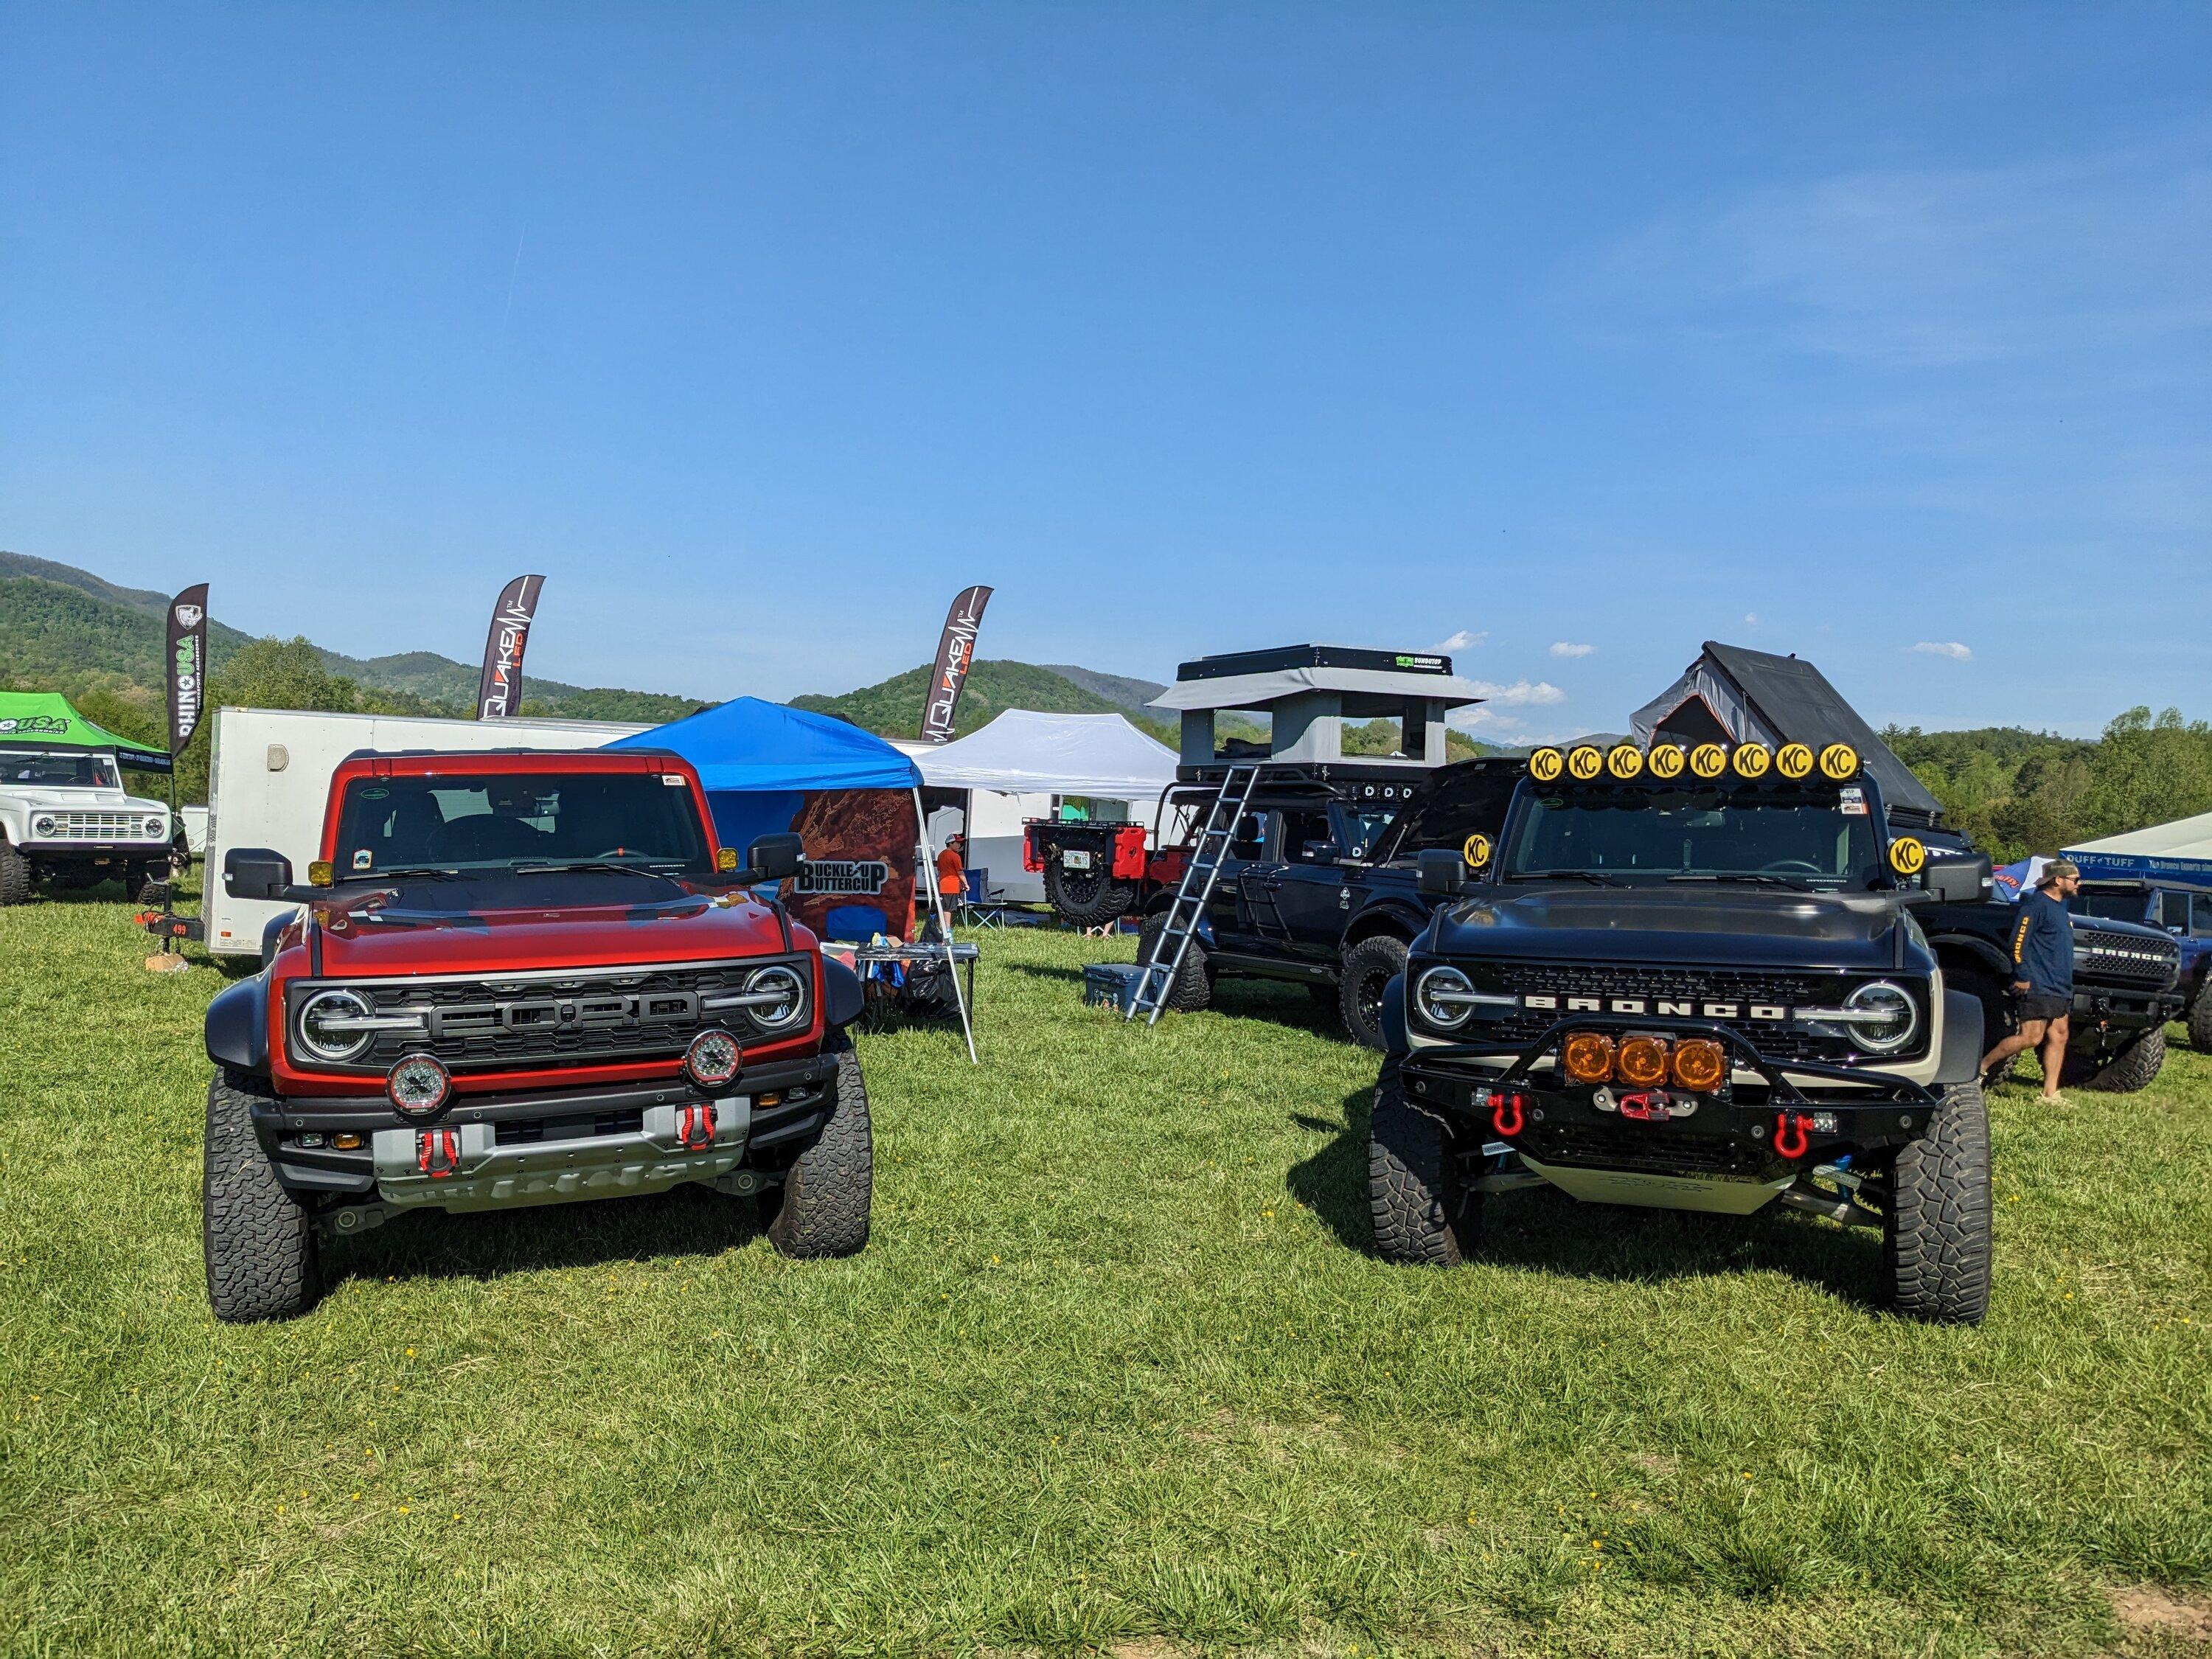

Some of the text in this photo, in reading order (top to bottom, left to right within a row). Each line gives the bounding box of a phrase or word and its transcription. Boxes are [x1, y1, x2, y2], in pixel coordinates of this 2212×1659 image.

[512, 633, 524, 667] LED
[959, 642, 973, 675] LED
[1414, 657, 1442, 665] BUNDUTOP
[1535, 751, 1557, 778] KC
[1573, 750, 1596, 776] KC
[1613, 748, 1637, 775] KC
[1654, 748, 1678, 775] KC
[1695, 747, 1721, 775] KC
[1738, 747, 1764, 774] KC
[1781, 747, 1807, 775] KC
[1825, 748, 1851, 776] KC
[1467, 837, 1485, 864] KC
[1895, 841, 1919, 870] KC
[2067, 854, 2135, 867] DUFF TUFF
[799, 876, 886, 891] BUTTERCUP
[800, 863, 853, 877] BUCKLE
[173, 924, 187, 935] 499
[2092, 947, 2162, 961] BRONCO
[430, 991, 699, 1037] FORD
[1525, 995, 1784, 1020] BRONCO
